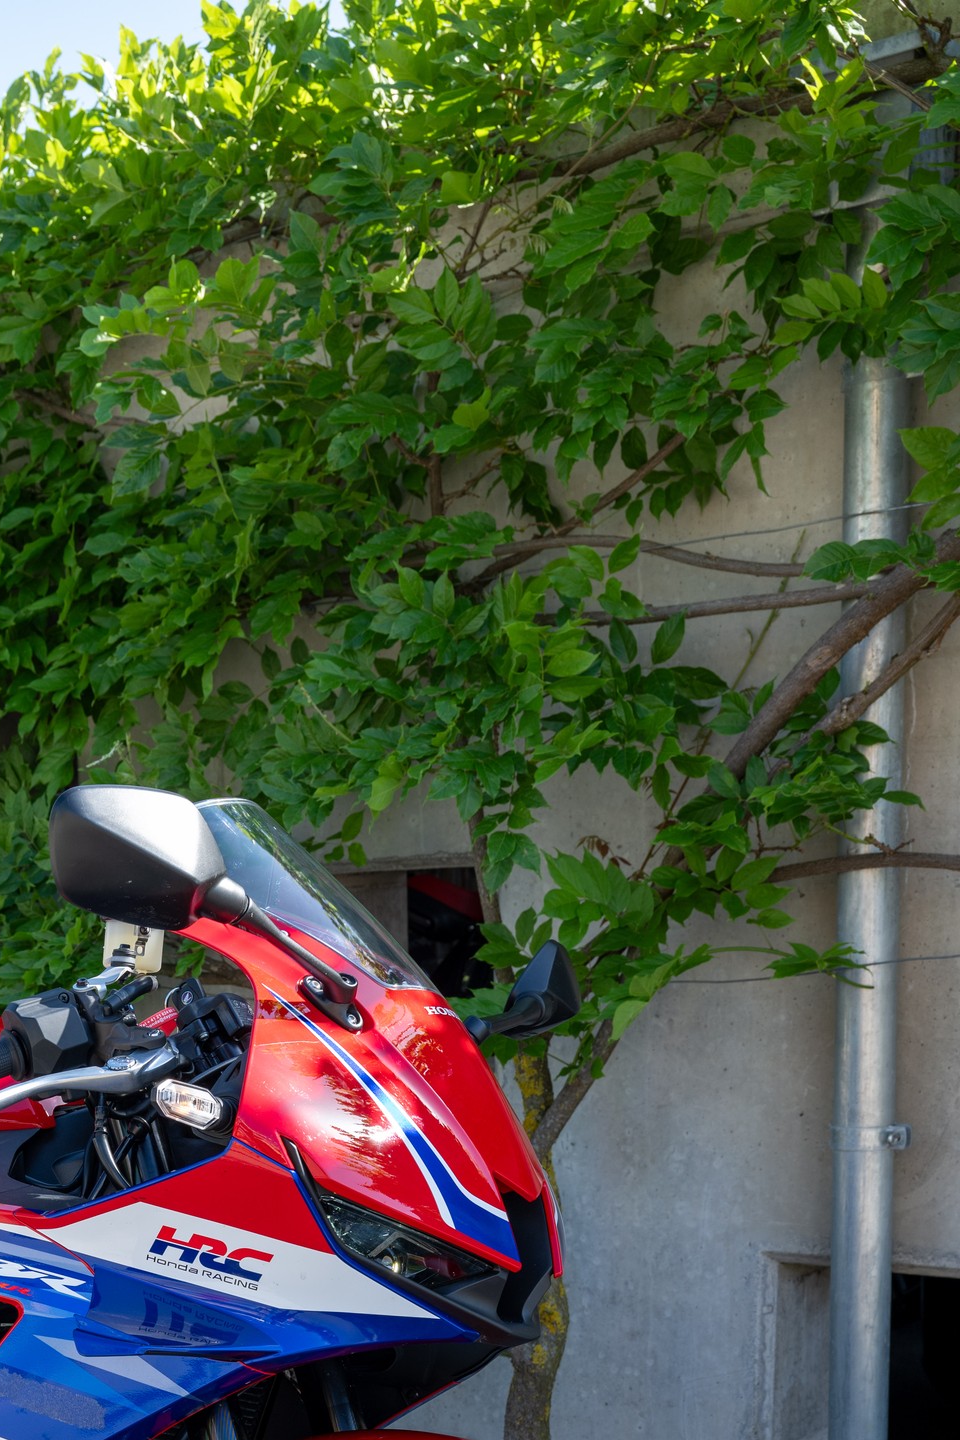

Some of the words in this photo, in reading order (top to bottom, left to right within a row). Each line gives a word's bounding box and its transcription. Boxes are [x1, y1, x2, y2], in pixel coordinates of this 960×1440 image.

[146, 1254, 198, 1274] Honda
[202, 1270, 258, 1291] RACING
[149, 1225, 274, 1282] HRC
